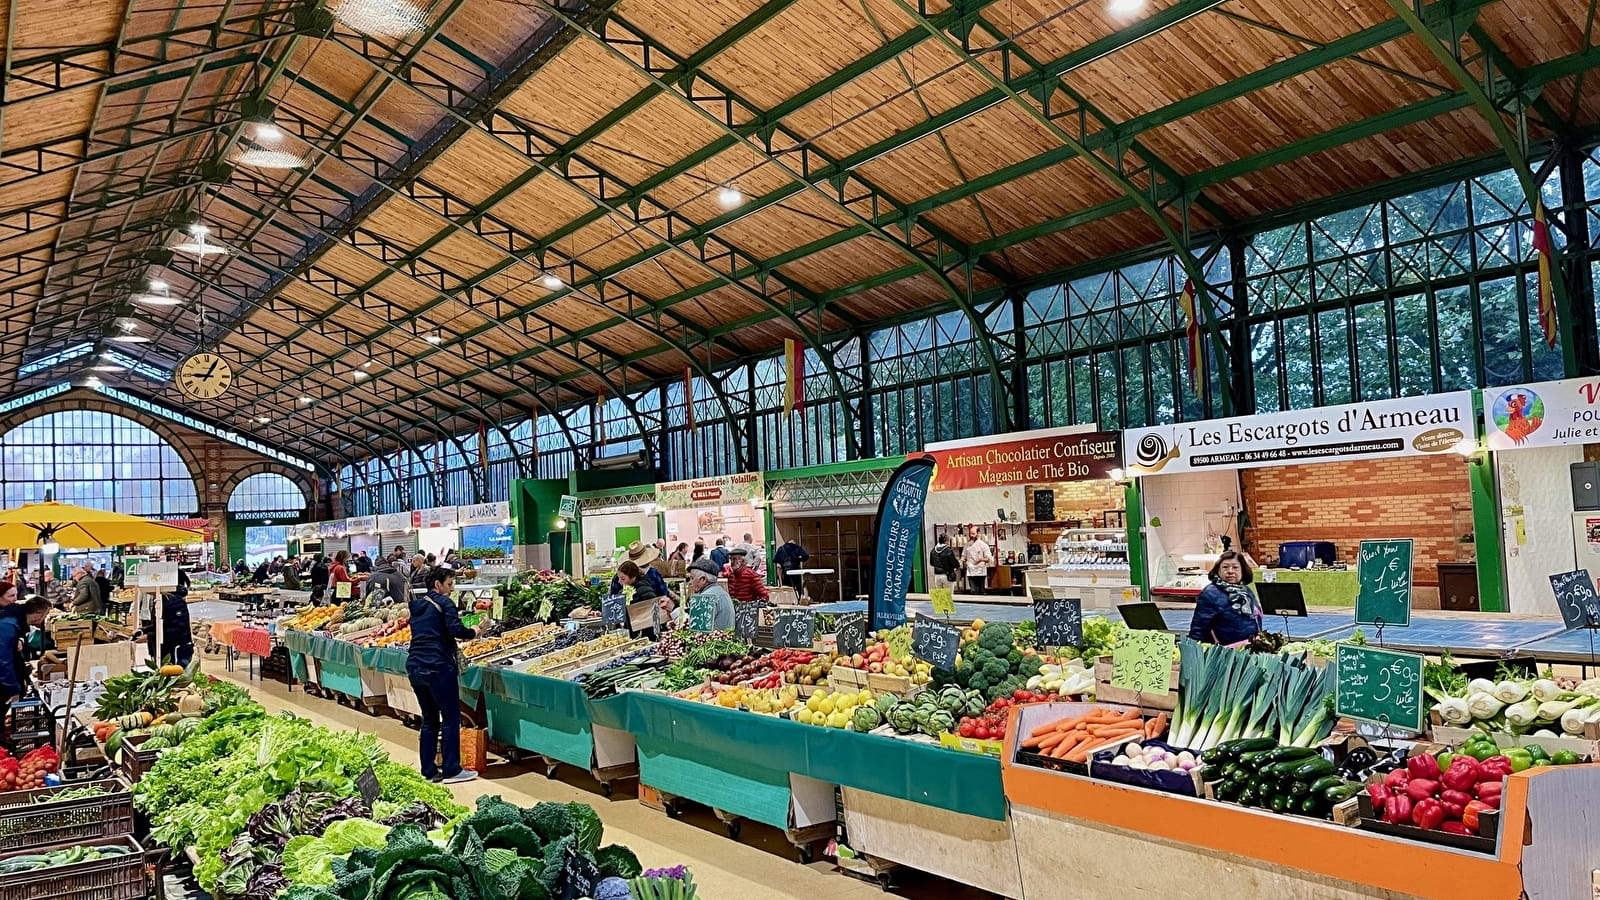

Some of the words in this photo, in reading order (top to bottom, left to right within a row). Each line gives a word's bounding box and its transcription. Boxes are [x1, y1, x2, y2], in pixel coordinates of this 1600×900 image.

[1189, 428, 1221, 447] Les
[1227, 419, 1330, 446] Escargots
[1337, 407, 1461, 433] d'Armeau
[1552, 427, 1582, 440] Julie
[1585, 427, 1598, 437] et
[1421, 434, 1436, 442] Vente
[1437, 430, 1455, 439] directe
[947, 455, 982, 469] Artisan
[986, 445, 1050, 465] Chocolatier
[1053, 438, 1116, 458] Confiseur
[1193, 456, 1210, 465] 89500
[1210, 454, 1240, 463] ARMEAU
[1269, 450, 1278, 458] 66
[978, 468, 1023, 486] Magasin
[1027, 466, 1039, 480] de
[1042, 463, 1064, 479] Thé
[1067, 461, 1090, 477] Bio
[660, 483, 687, 491] Boucherie
[691, 478, 726, 488] Charcuterie
[731, 475, 758, 484] Volailles
[470, 508, 477, 518] LA
[477, 504, 497, 517] MARINE
[884, 520, 900, 602] PRODUCTEURS
